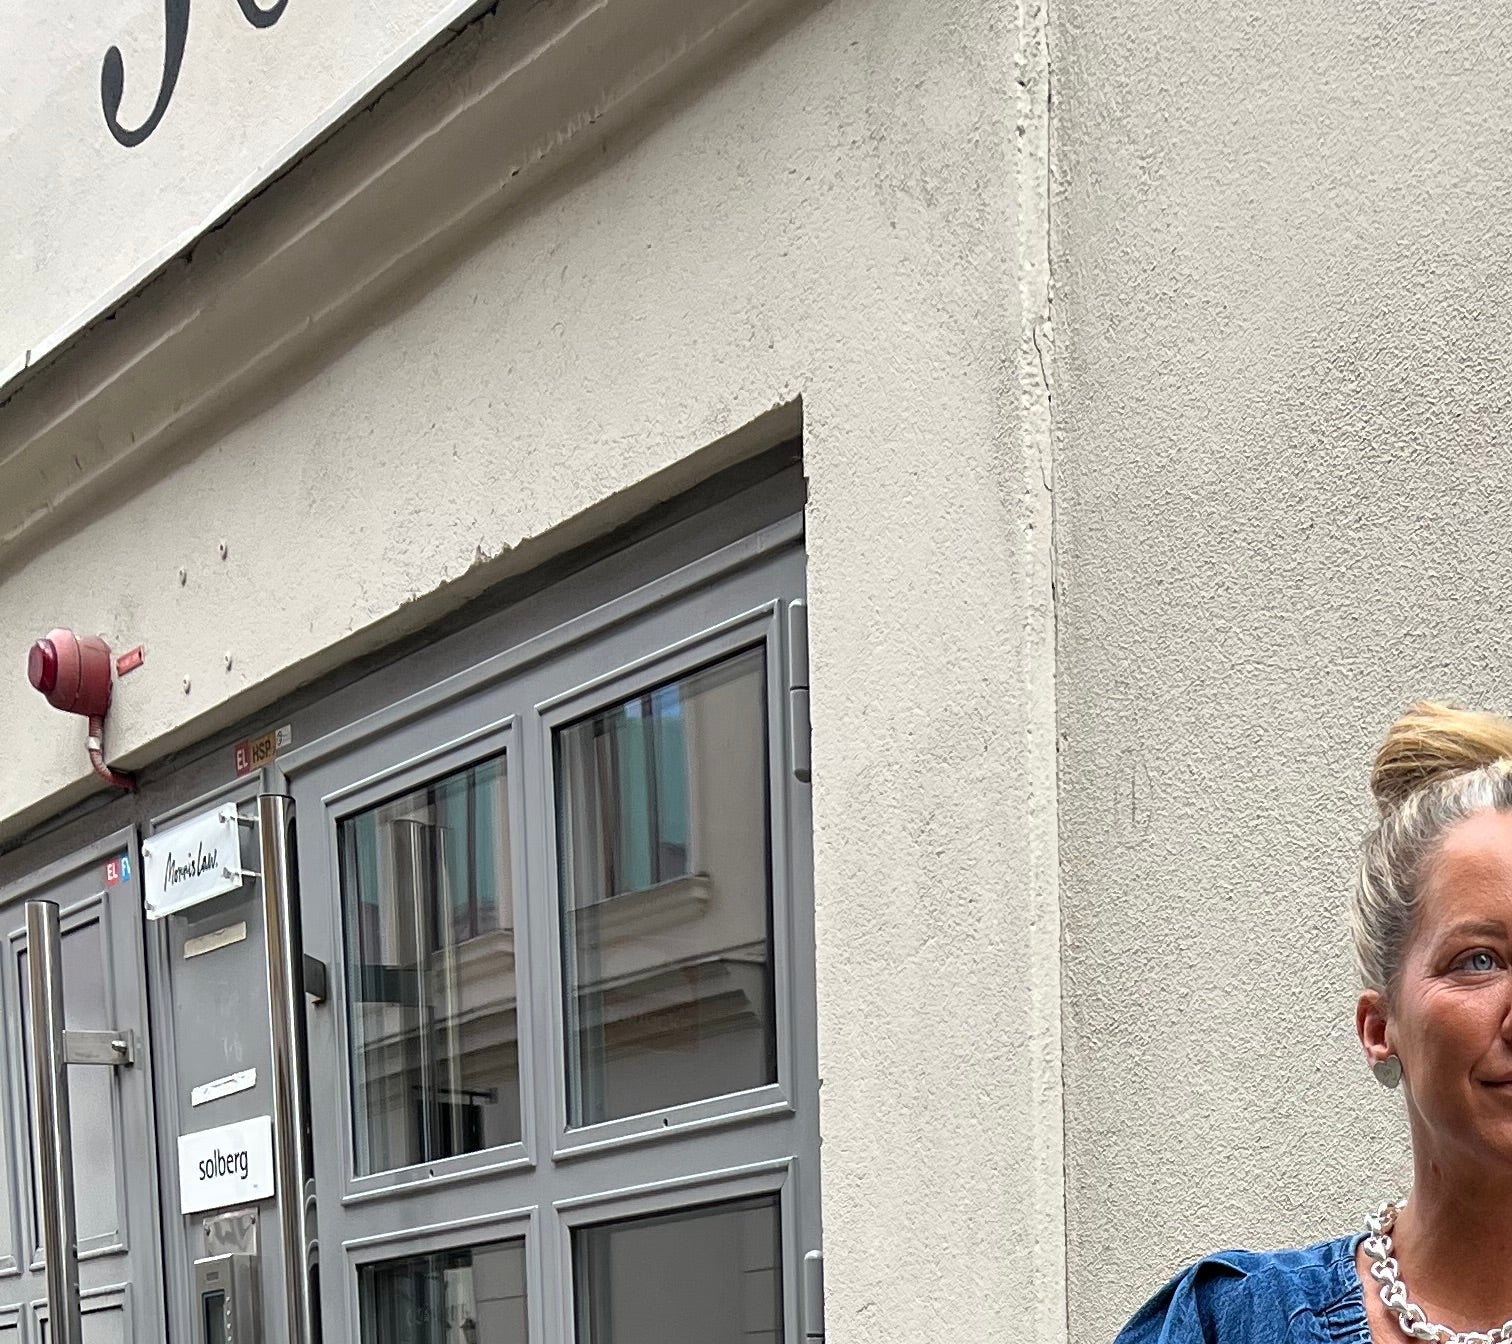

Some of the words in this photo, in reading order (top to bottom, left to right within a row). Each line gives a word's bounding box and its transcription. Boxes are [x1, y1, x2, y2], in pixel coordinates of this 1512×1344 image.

[236, 748, 249, 770] EL
[107, 862, 119, 881] EL
[199, 1148, 248, 1181] solberg
